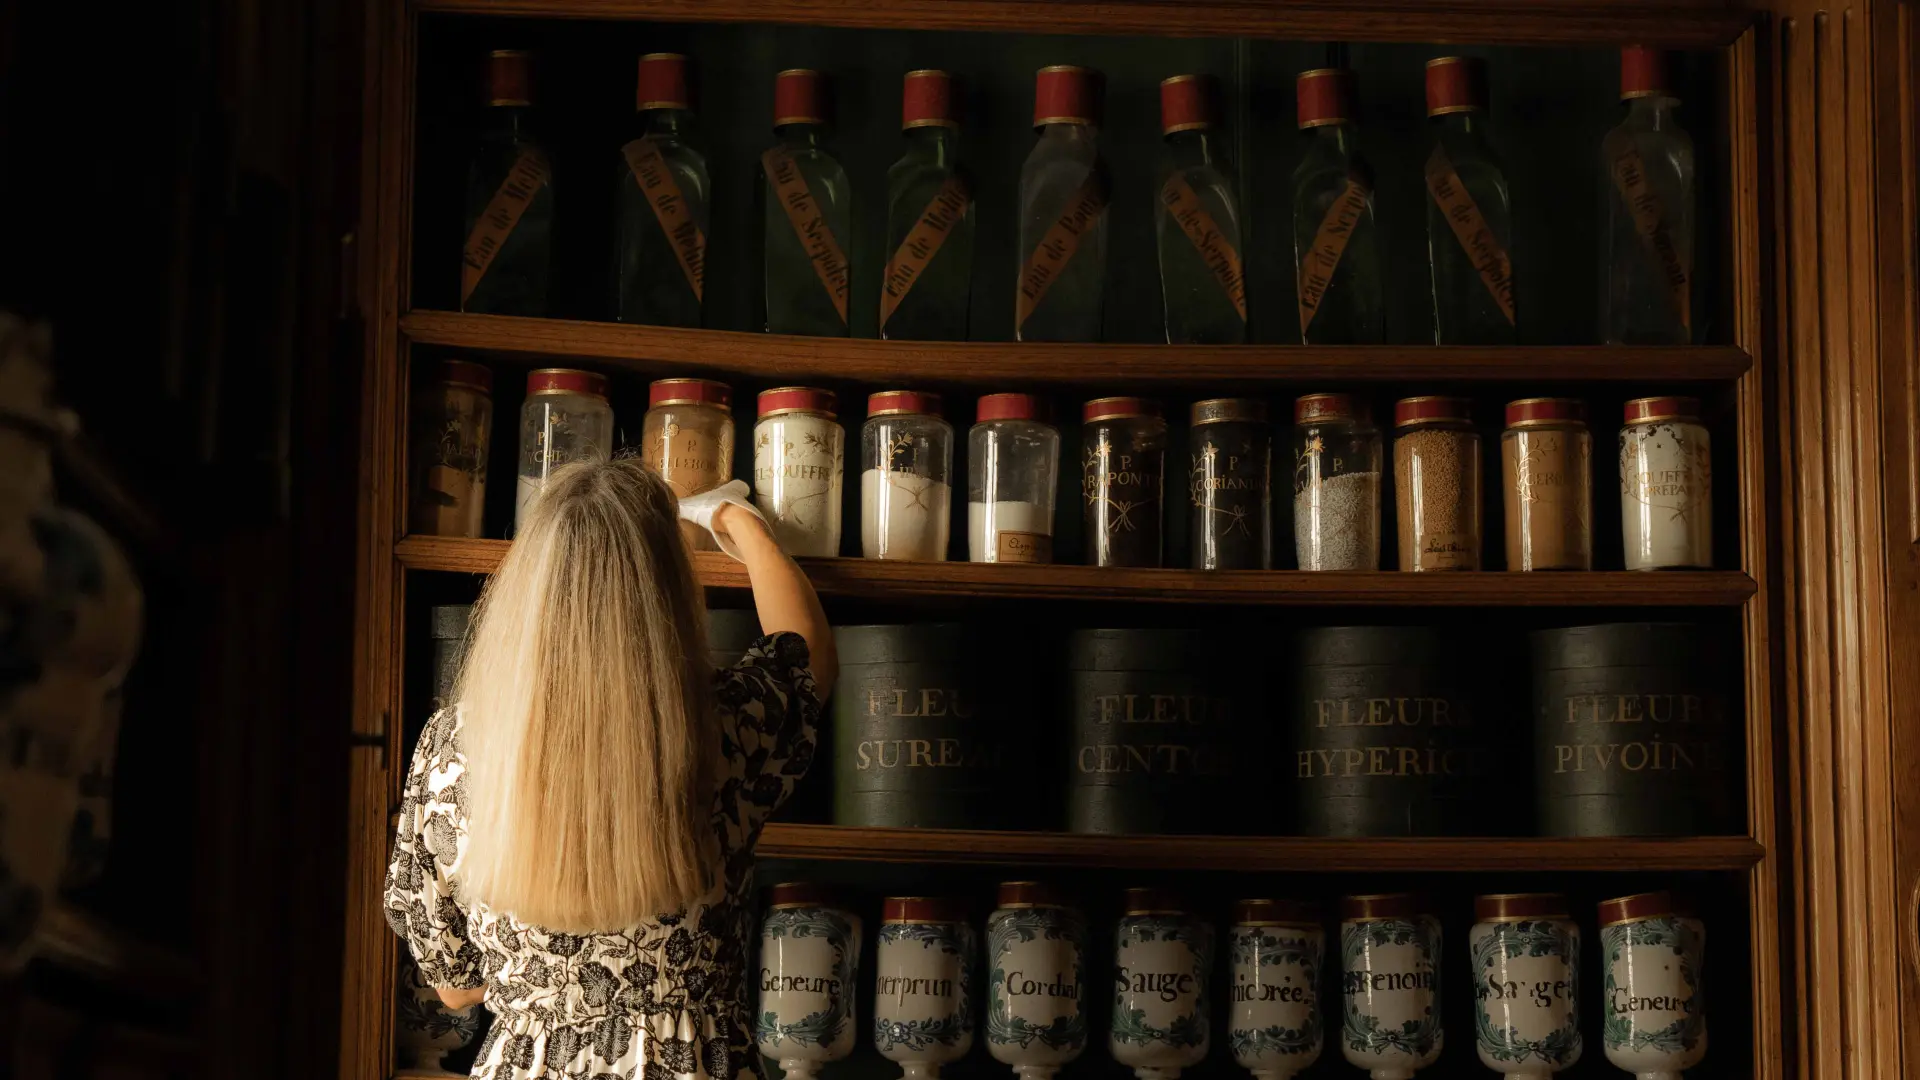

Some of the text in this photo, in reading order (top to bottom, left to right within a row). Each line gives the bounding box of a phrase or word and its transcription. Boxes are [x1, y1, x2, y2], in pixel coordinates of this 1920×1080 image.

[657, 194, 679, 215] de
[788, 191, 811, 213] de
[1452, 203, 1475, 224] de
[488, 208, 512, 230] de
[908, 237, 931, 260] de
[1042, 239, 1066, 262] de
[1316, 244, 1338, 268] de
[867, 687, 974, 718] FLEU
[1114, 966, 1194, 1003] Sauge
